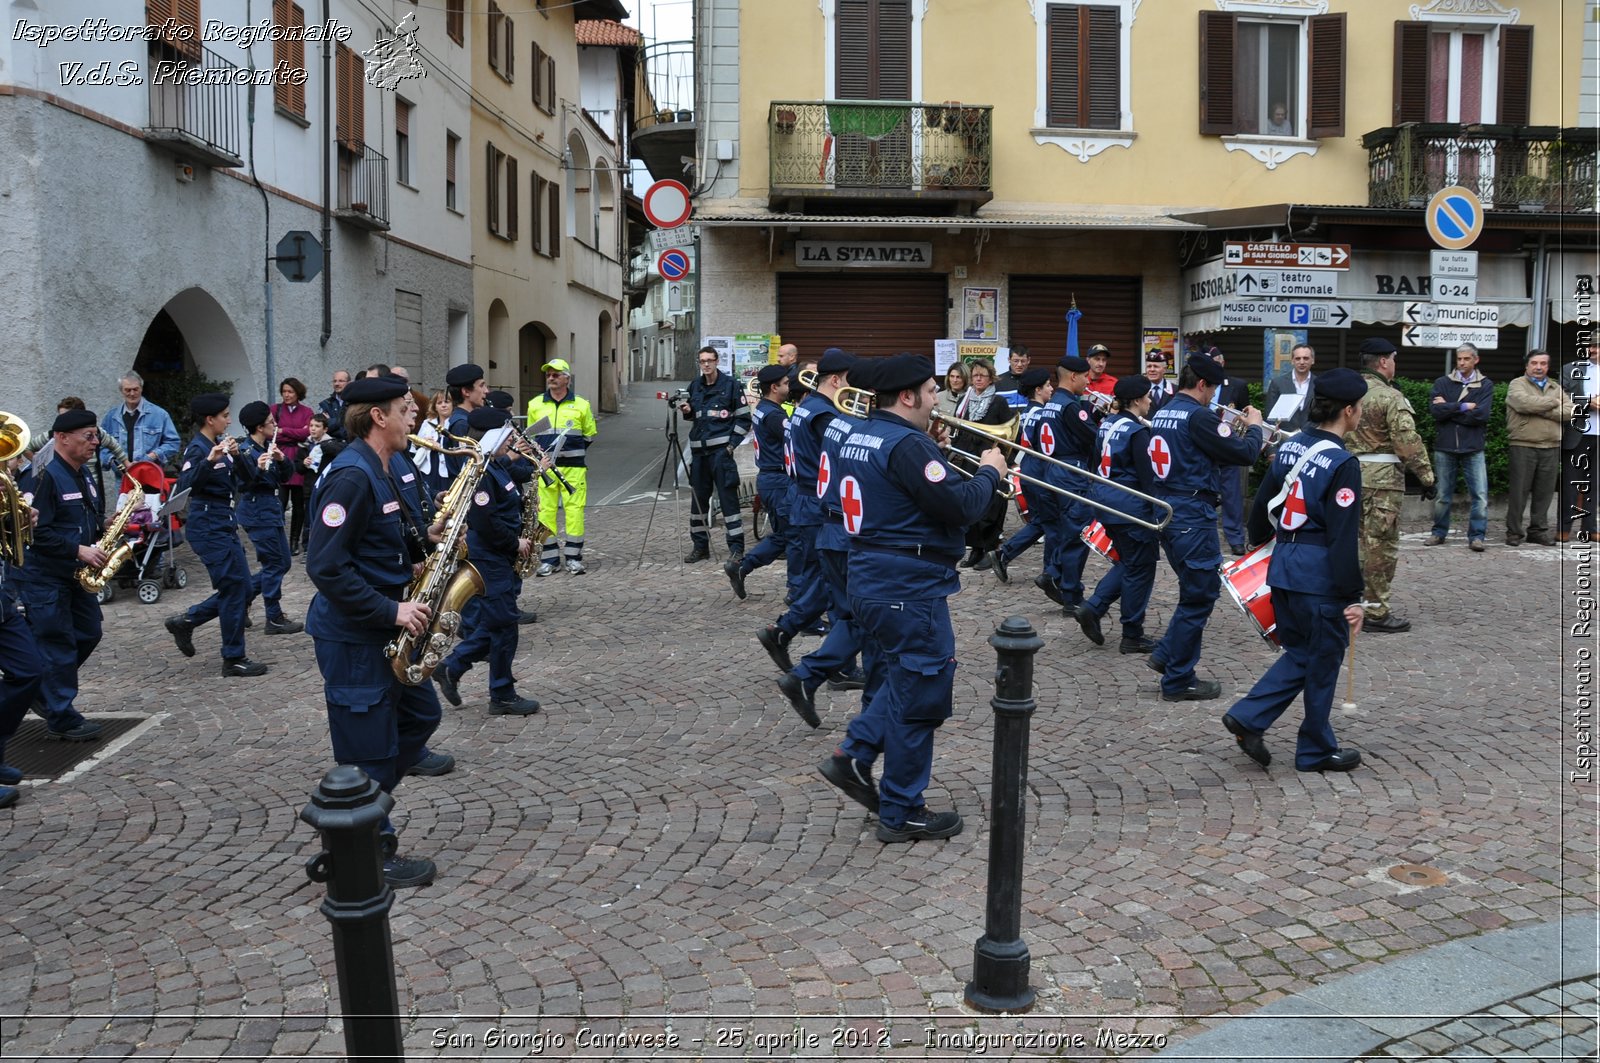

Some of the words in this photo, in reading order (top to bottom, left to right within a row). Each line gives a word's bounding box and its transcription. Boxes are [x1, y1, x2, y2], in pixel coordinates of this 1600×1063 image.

[1248, 244, 1291, 252] CASTELLO
[802, 247, 832, 261] LA
[837, 247, 925, 262] STAMPA
[1281, 272, 1312, 282] teatro
[1281, 285, 1333, 294] comunale
[1375, 275, 1432, 295] BAR
[1440, 284, 1469, 297] 0-24
[1224, 304, 1255, 312] MUSEO
[1258, 304, 1287, 313] CIVICO
[1437, 307, 1498, 323] municipio
[1440, 331, 1457, 341] centro
[1460, 331, 1481, 343] sportivo
[1279, 453, 1317, 478] FANRA
